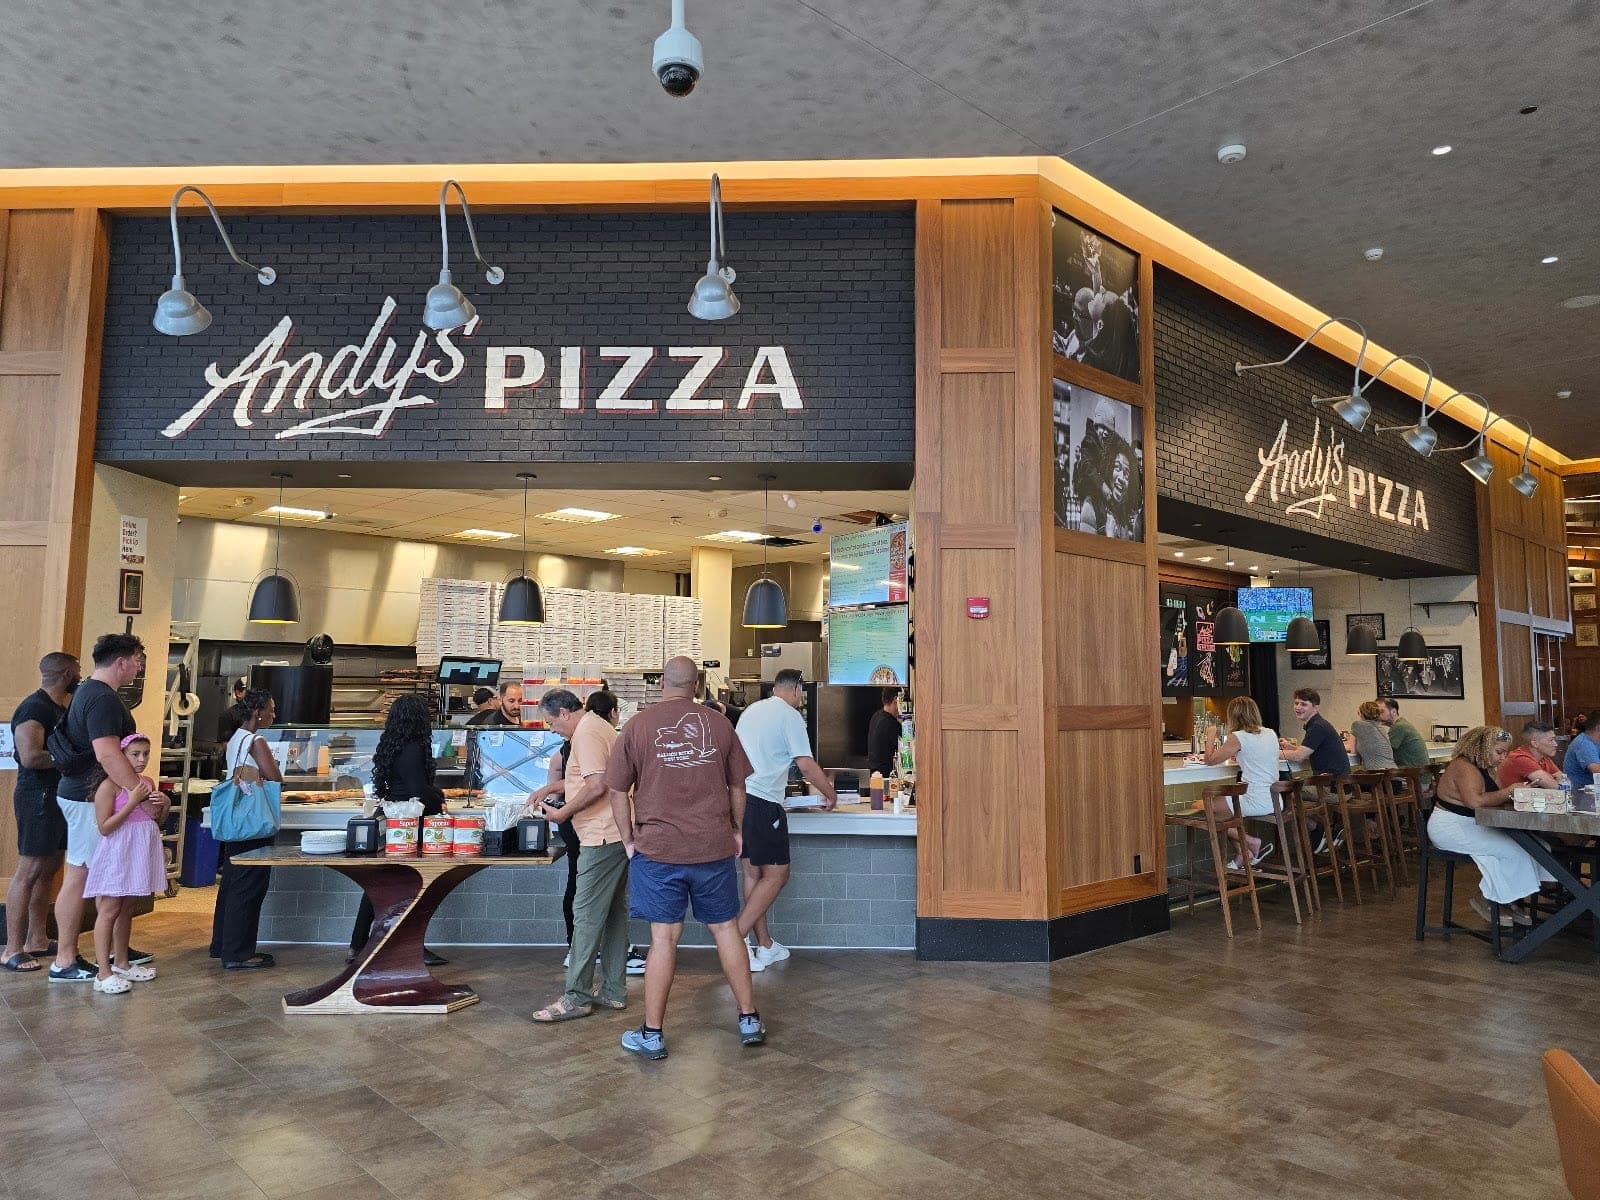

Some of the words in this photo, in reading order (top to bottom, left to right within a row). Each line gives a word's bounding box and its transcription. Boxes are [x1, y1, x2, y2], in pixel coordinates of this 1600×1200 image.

[161, 295, 479, 439] Andys
[484, 345, 805, 412] PIZZA
[1245, 416, 1345, 519] Andy's
[1348, 464, 1430, 531] PIZZA
